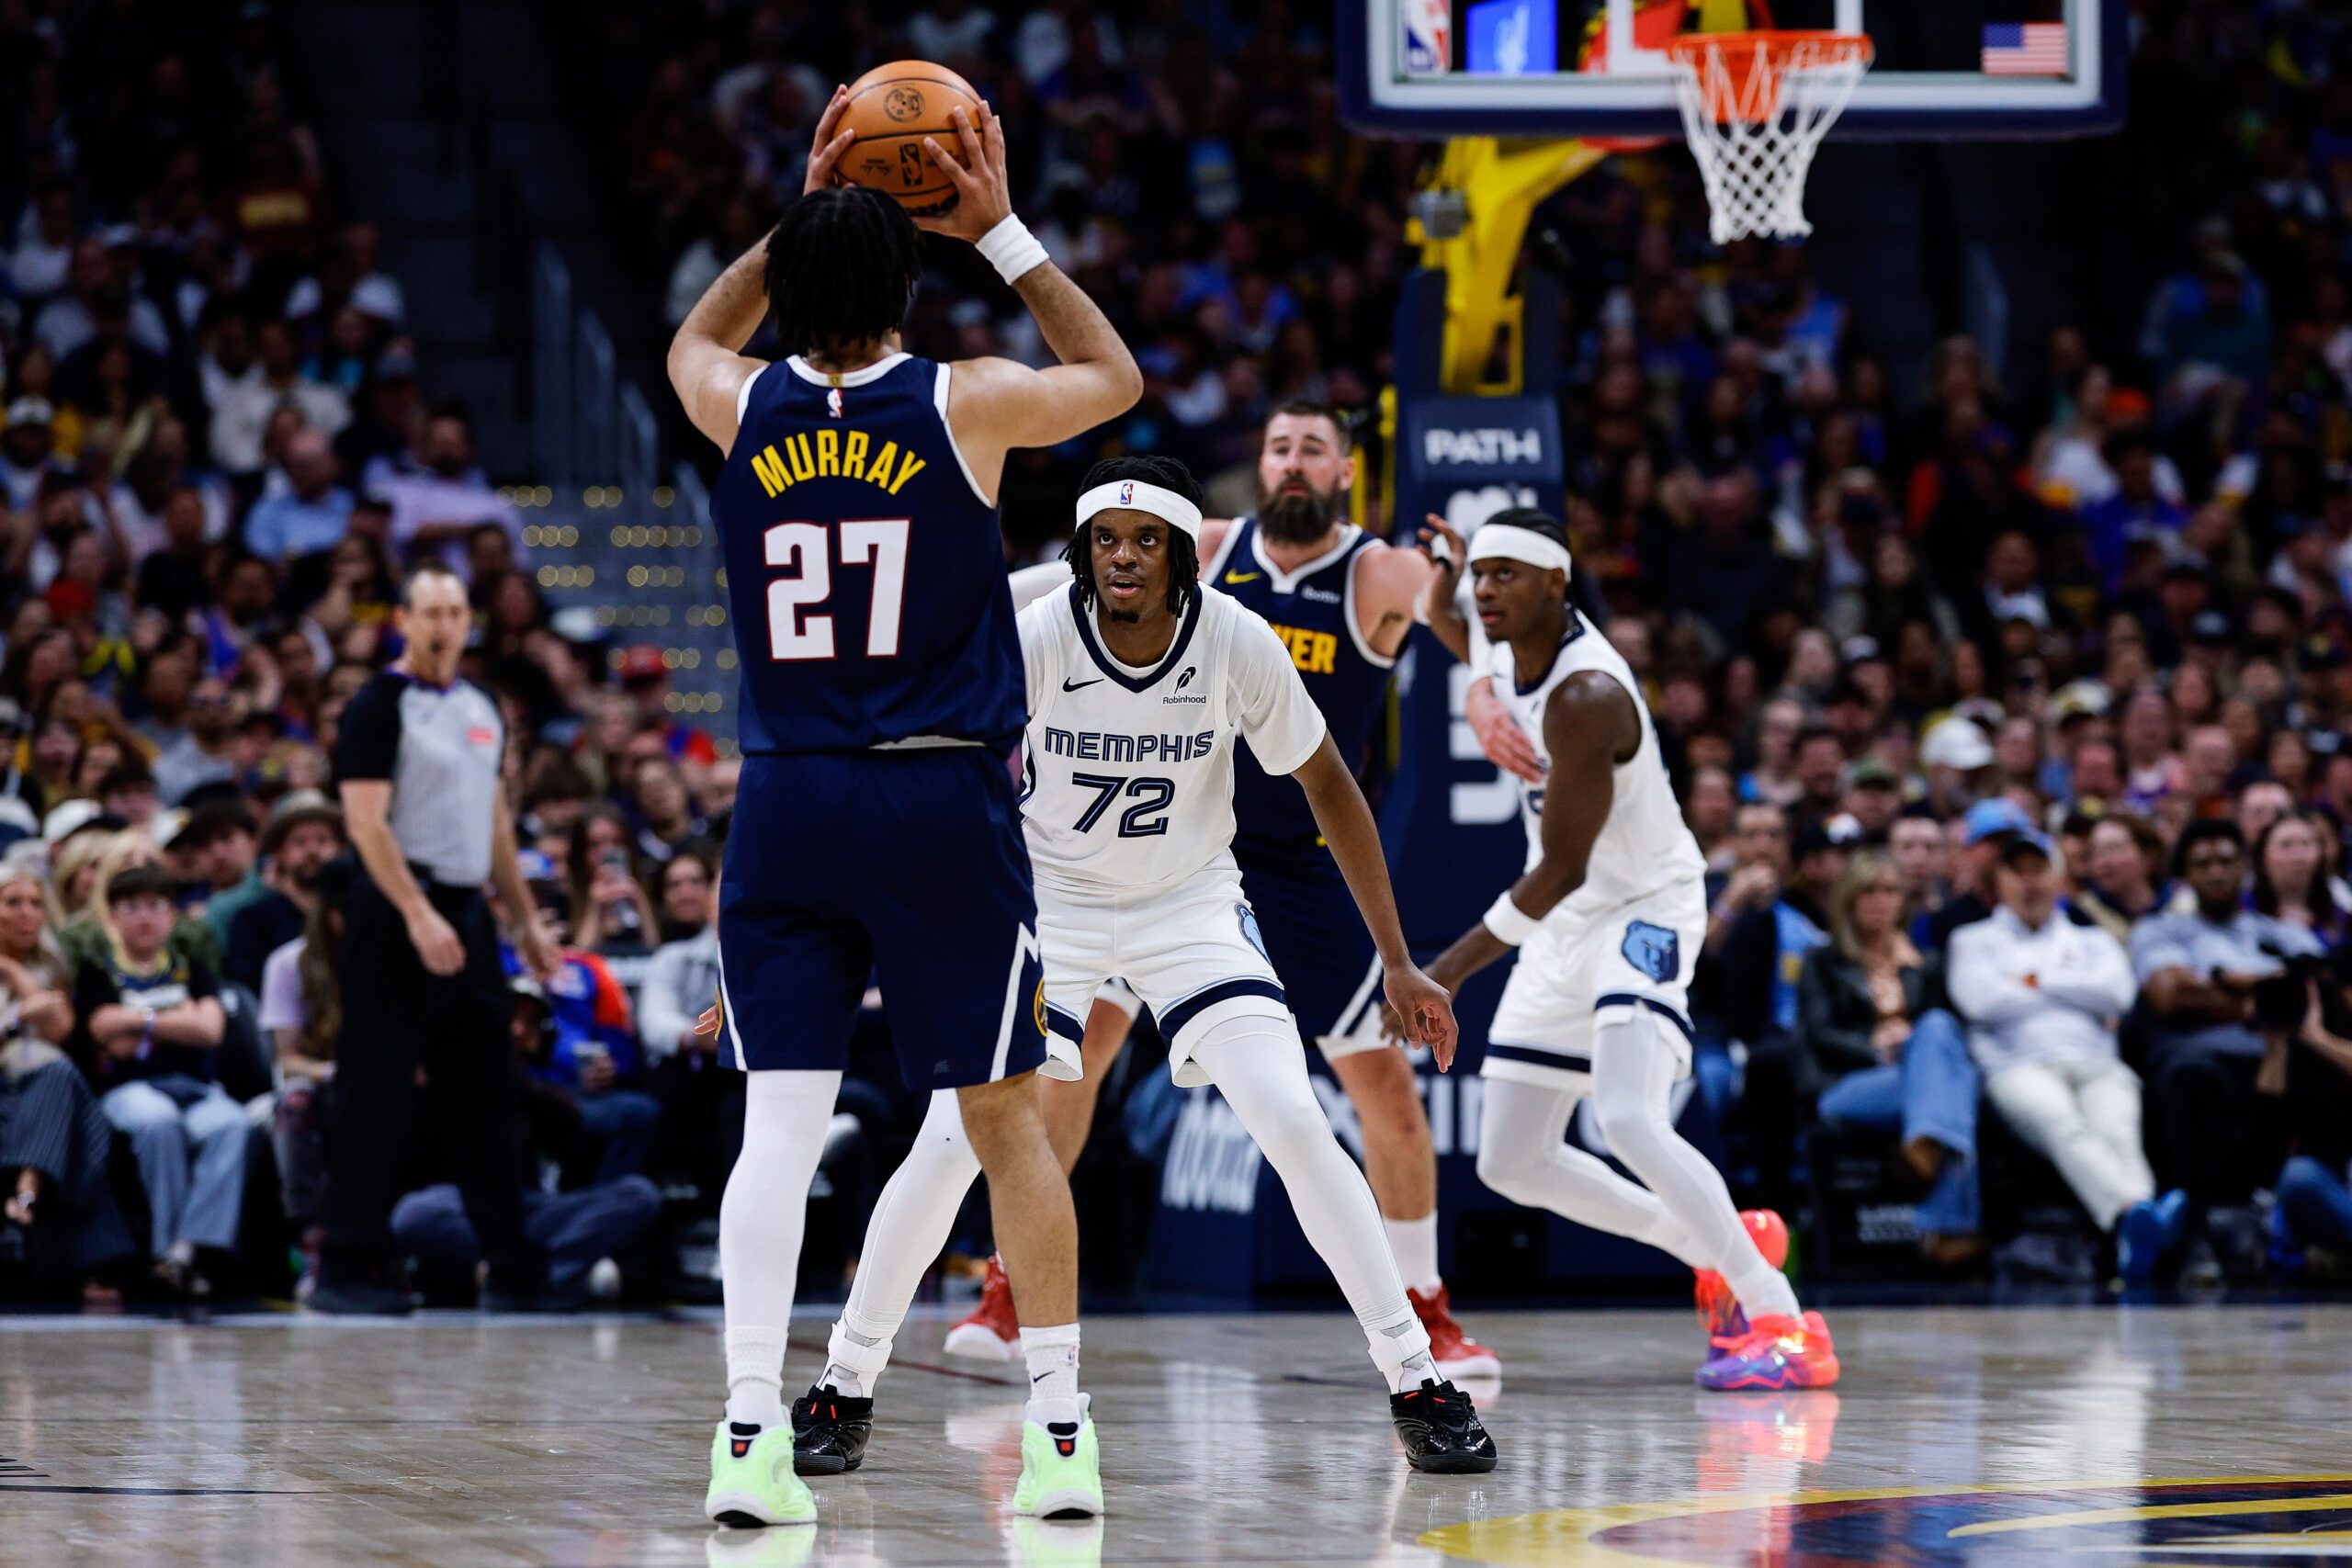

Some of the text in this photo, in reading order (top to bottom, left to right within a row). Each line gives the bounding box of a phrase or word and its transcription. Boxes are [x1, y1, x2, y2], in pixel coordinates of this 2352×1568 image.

[751, 429, 927, 499] MURRAY
[1425, 427, 1542, 465] PATH
[762, 516, 913, 662] 27
[1162, 695, 1206, 705] Robinhood
[1045, 727, 1215, 762] MEMPHIS
[1071, 772, 1176, 838] 72
